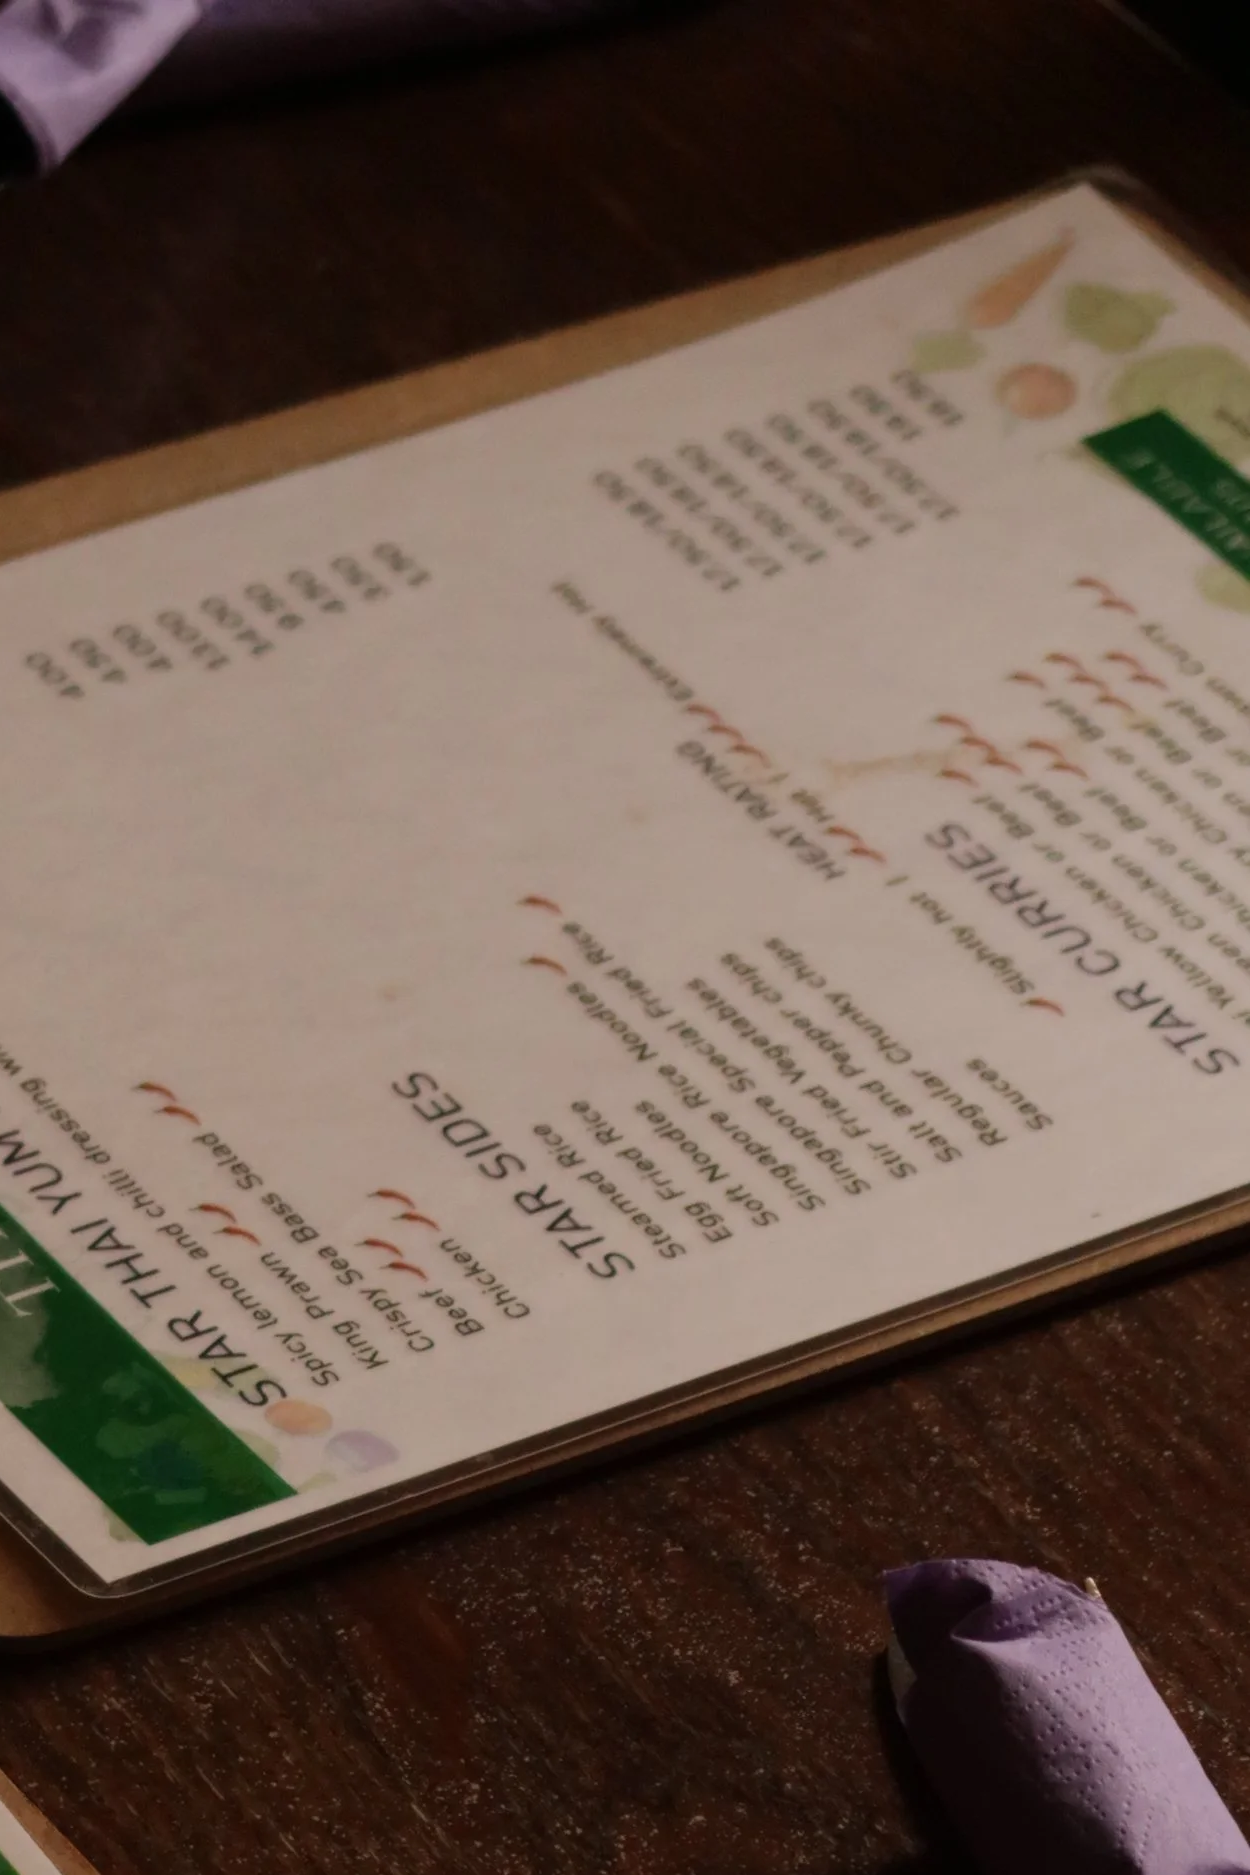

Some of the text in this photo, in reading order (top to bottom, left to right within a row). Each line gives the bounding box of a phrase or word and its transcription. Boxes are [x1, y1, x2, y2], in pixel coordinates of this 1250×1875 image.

[675, 740, 846, 881] HEAT RATING
[909, 892, 1035, 996] Slightly hot
[924, 822, 1239, 1075] STAR CURRIES
[560, 922, 872, 1196] Singapore Special Fried Rice
[566, 981, 826, 1212] Singapore Rice Noodles
[685, 978, 918, 1180] Stir Fried Vegetables
[719, 952, 963, 1164] Salt and Pepper chips
[763, 937, 1008, 1148] Regular Chunky chips
[965, 1058, 1054, 1131] Sauces
[18, 1077, 112, 1166] dressing
[391, 1072, 636, 1280] STAR SIDES
[570, 1101, 734, 1244] Egg Fried Rice
[634, 1100, 780, 1227] Soft Noodles
[103, 1168, 166, 1219] chilli
[155, 1222, 210, 1261] and
[192, 1132, 436, 1353] Crispy Sea Bass Salad
[532, 1124, 687, 1260] Steamed Rice
[69, 1218, 177, 1309] THAI
[205, 1264, 279, 1331] lemon
[259, 1252, 389, 1370] King Prawn
[418, 1289, 485, 1337] Beef
[437, 1238, 531, 1320] Chicken
[166, 1310, 288, 1408] STAR
[273, 1332, 341, 1388] Spicy
